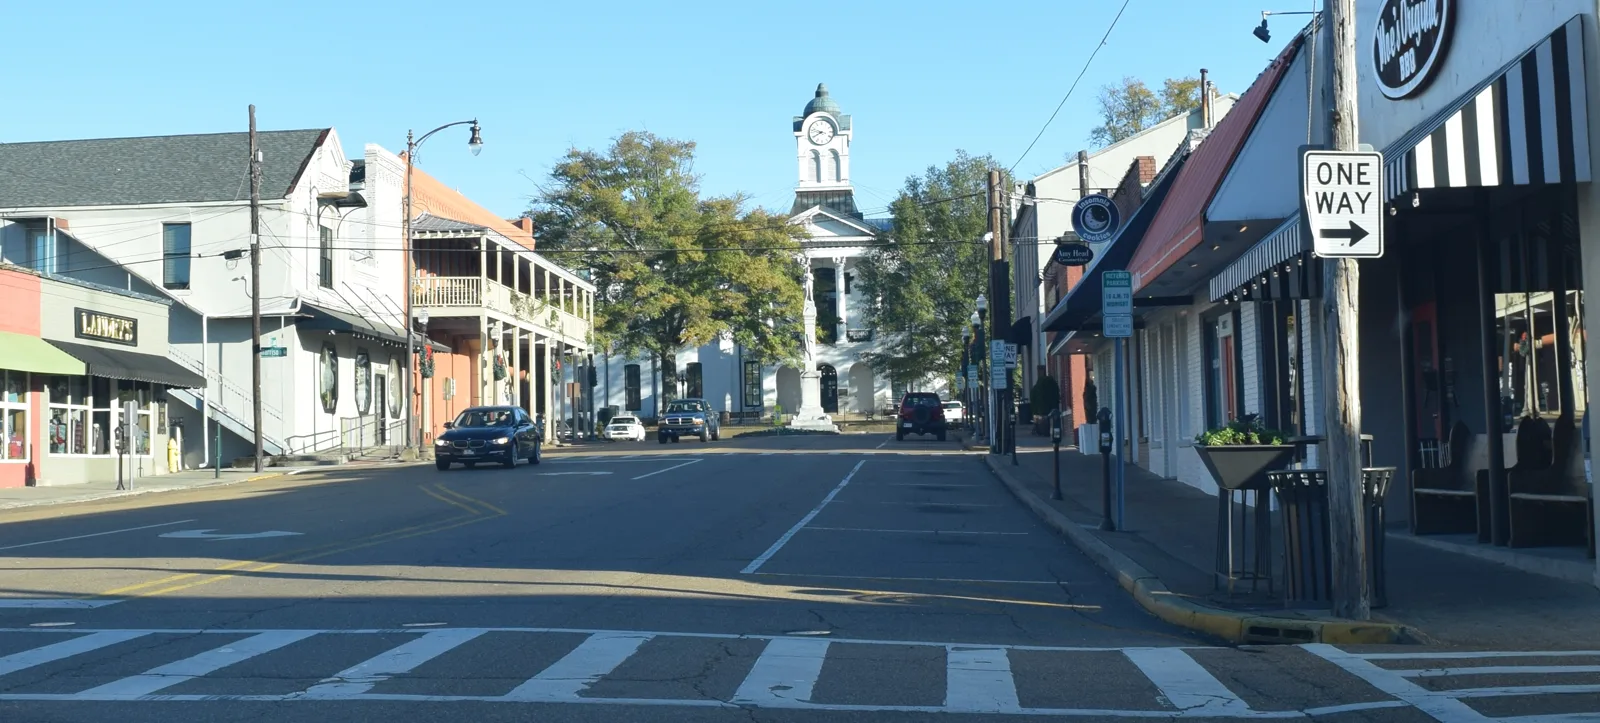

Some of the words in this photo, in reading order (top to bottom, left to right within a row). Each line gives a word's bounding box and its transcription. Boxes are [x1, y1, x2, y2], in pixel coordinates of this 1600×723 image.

[1399, 47, 1417, 82] BBQ
[1316, 162, 1371, 186] ONE
[1315, 191, 1373, 215] WAY
[1082, 231, 1111, 241] cookies
